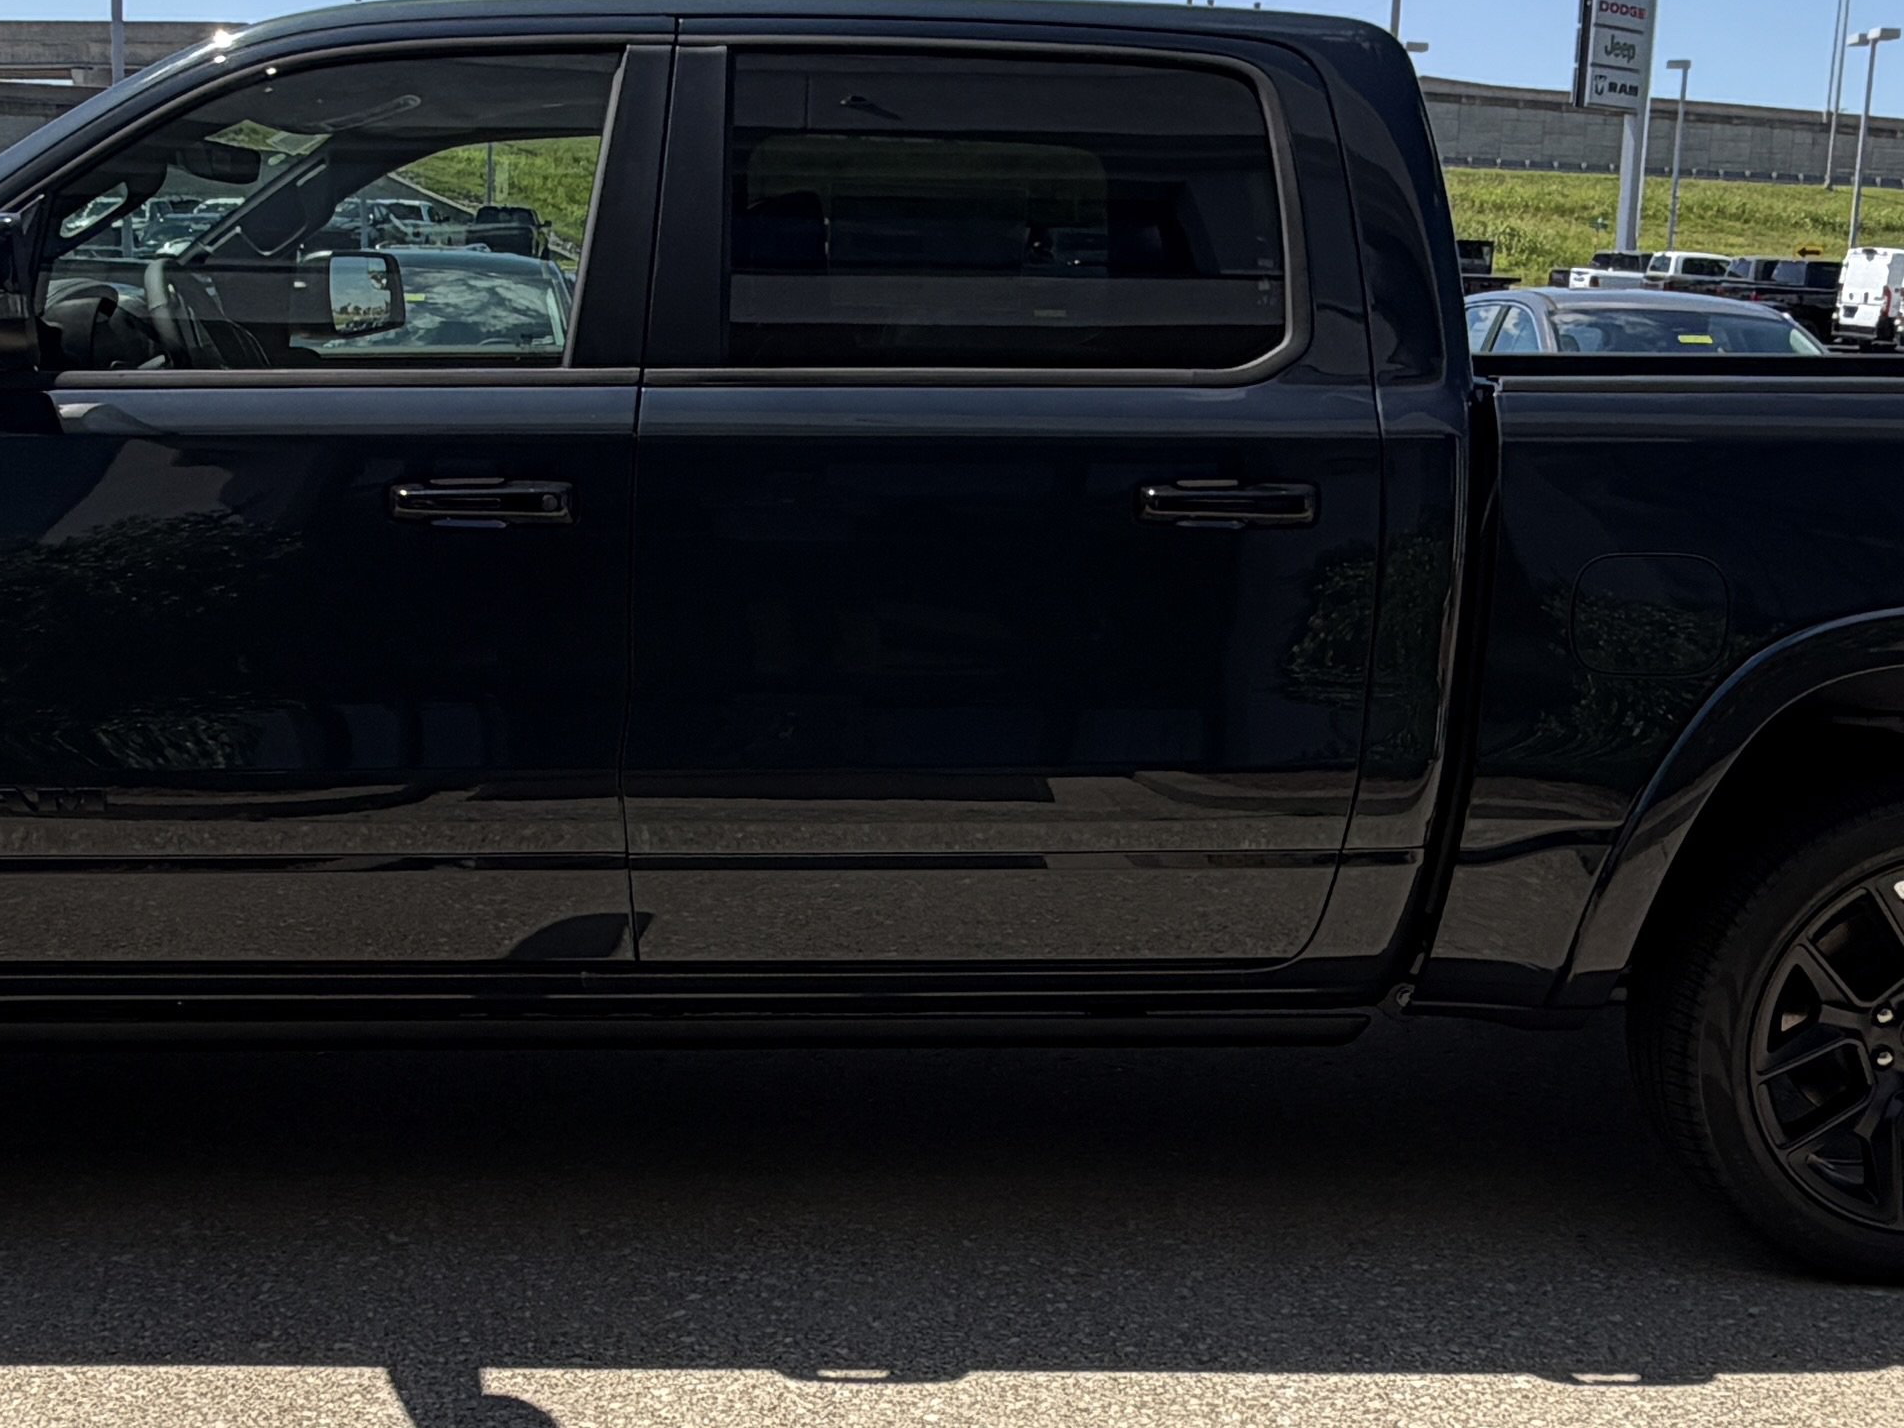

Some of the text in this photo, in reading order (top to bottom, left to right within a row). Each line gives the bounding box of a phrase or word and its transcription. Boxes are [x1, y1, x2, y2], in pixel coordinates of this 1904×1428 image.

[1599, 0, 1646, 21] DODGE
[1604, 34, 1636, 64] Jeep
[1608, 81, 1639, 97] RAM
